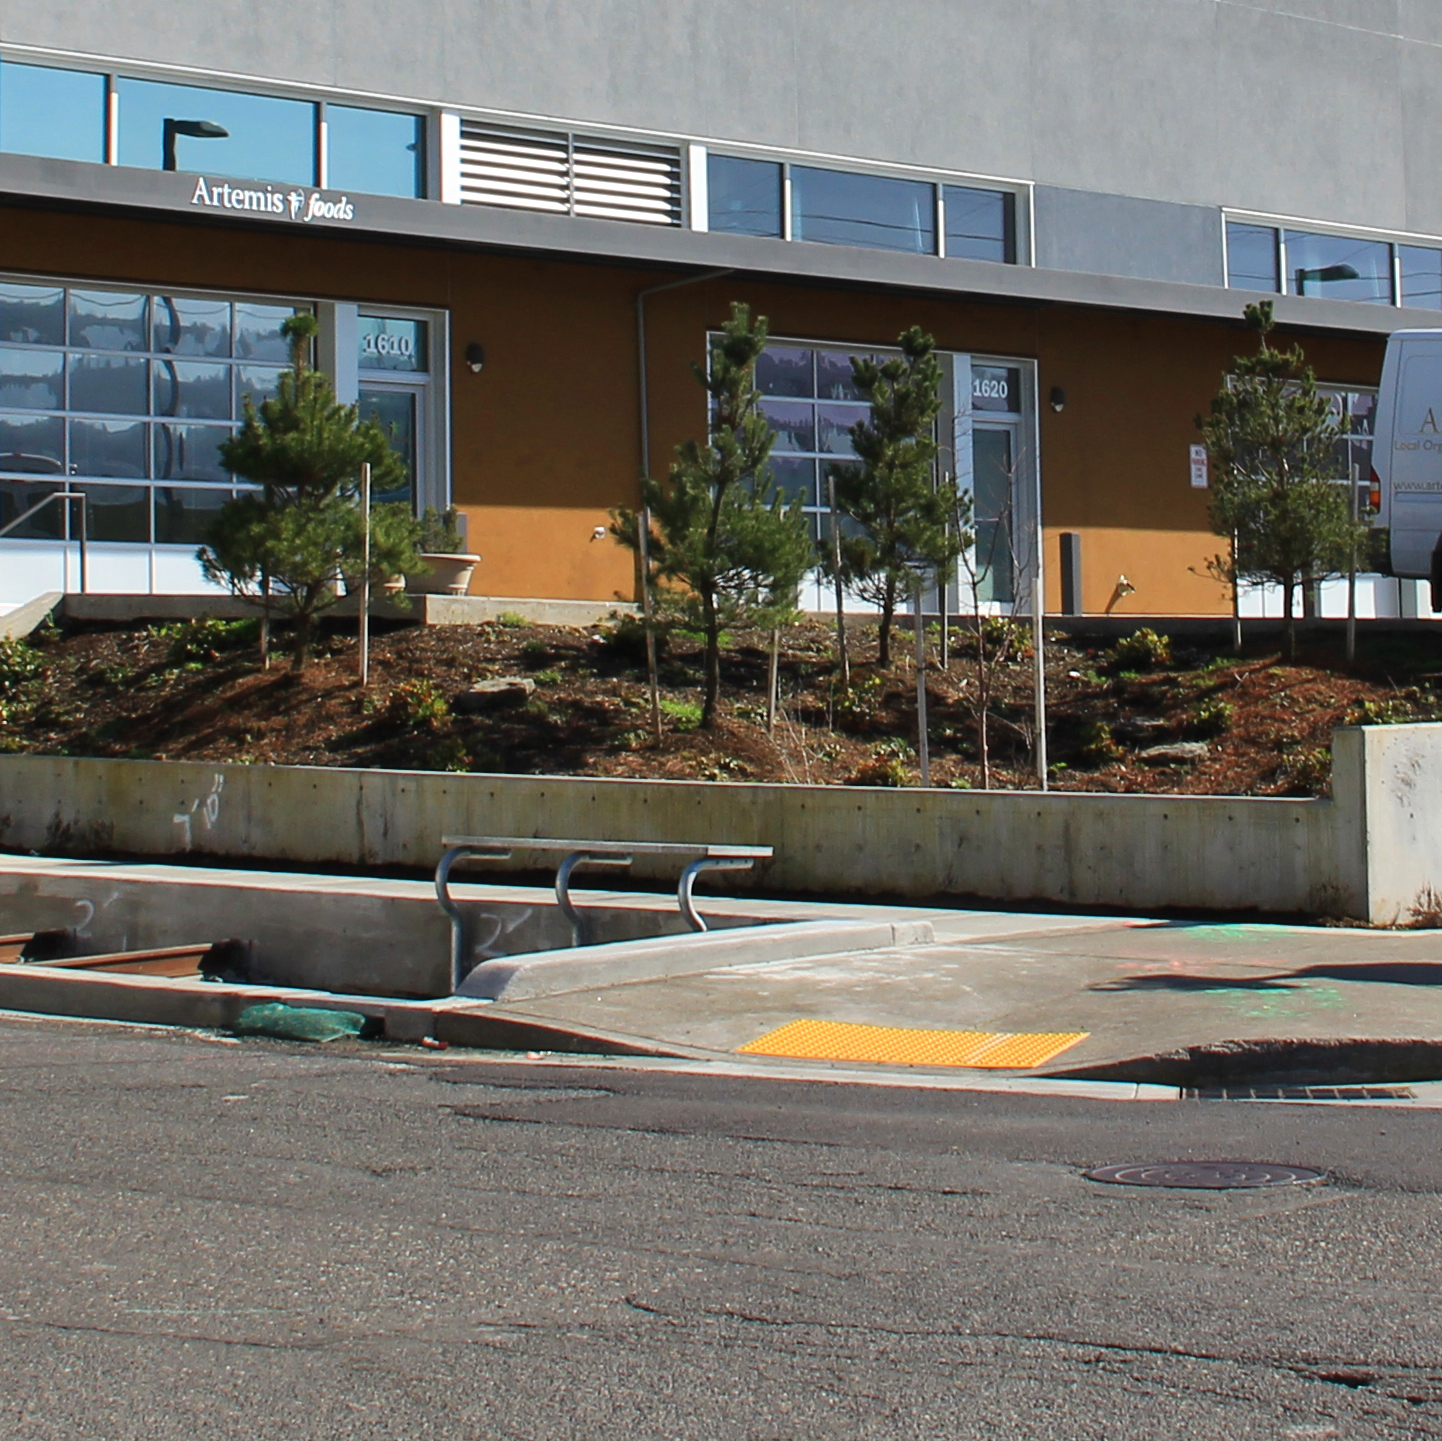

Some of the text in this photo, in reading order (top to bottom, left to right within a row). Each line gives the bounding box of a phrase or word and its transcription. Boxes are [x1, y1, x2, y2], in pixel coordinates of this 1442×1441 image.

[191, 176, 354, 222] Artemis foods
[362, 332, 411, 356] 1610
[972, 378, 1008, 398] 1620
[1394, 441, 1420, 451] Local
